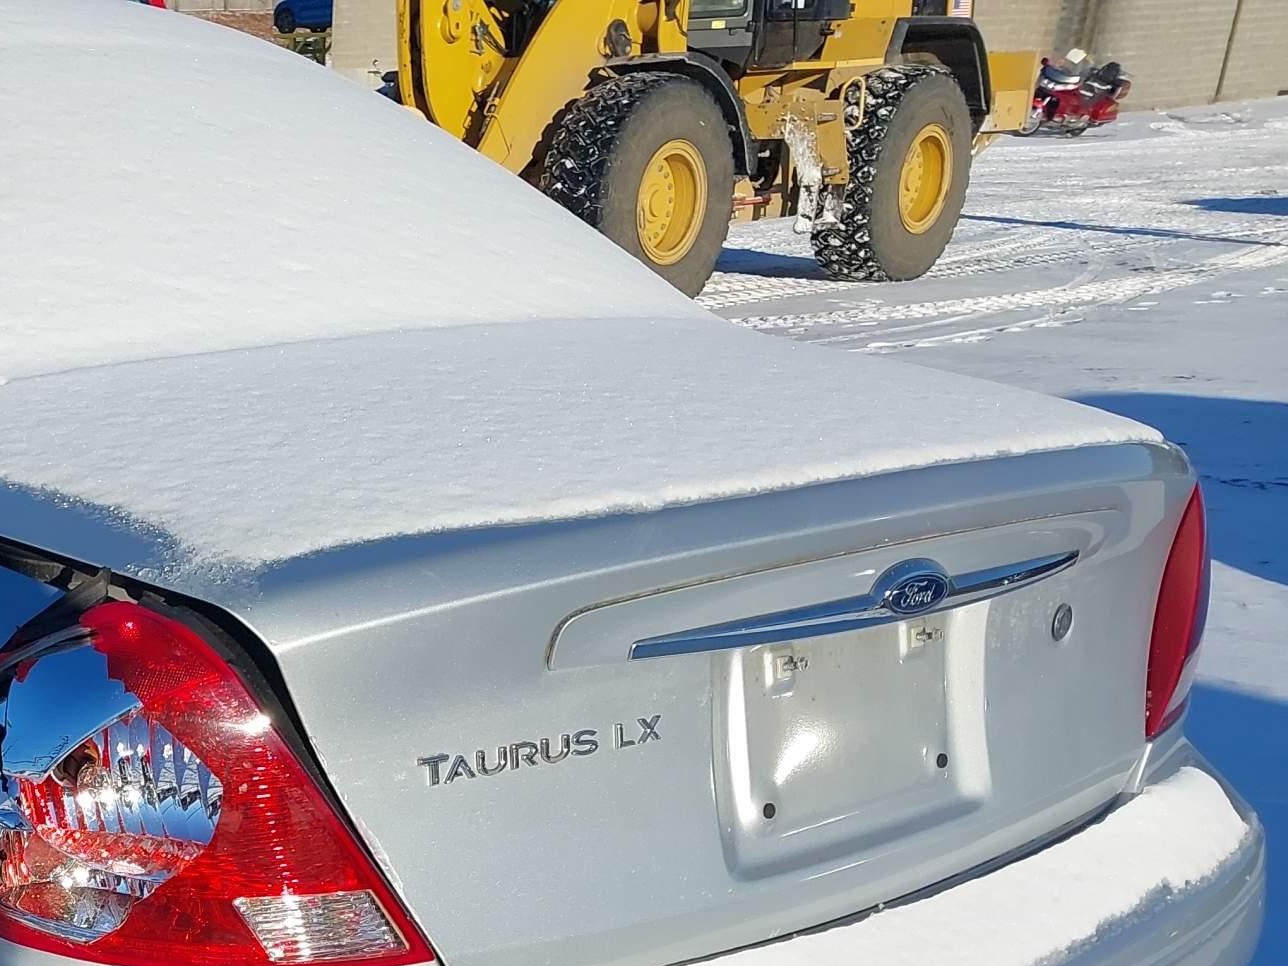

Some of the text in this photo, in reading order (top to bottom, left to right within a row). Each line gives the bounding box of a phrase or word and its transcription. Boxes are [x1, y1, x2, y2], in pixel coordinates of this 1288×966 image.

[899, 580, 936, 608] Ford
[417, 714, 662, 787] TAURUS LX
